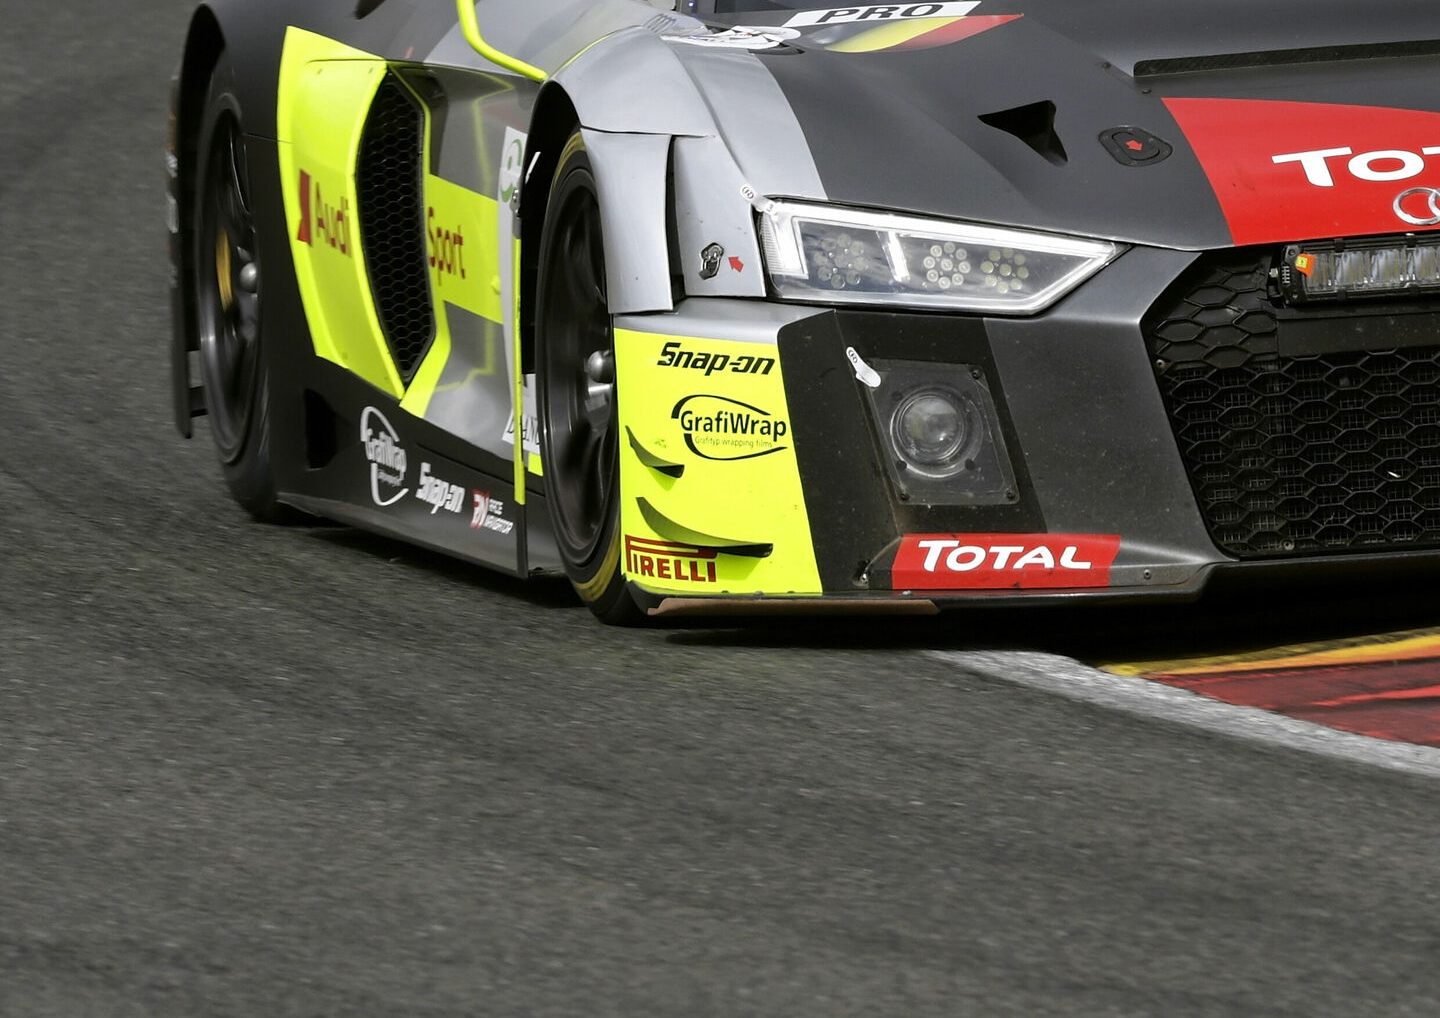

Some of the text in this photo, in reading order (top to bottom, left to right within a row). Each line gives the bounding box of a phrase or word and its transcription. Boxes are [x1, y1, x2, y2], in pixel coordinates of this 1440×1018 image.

[815, 4, 944, 24] PRO
[315, 182, 466, 287] Audi Sport
[657, 342, 776, 376] Snap-on
[681, 410, 787, 443] GrafiWrap
[695, 436, 772, 448] Grafityp wrapping films
[415, 462, 465, 514] Snap-on
[625, 534, 718, 583] PIRELLI
[918, 539, 1092, 572] TOTAL
